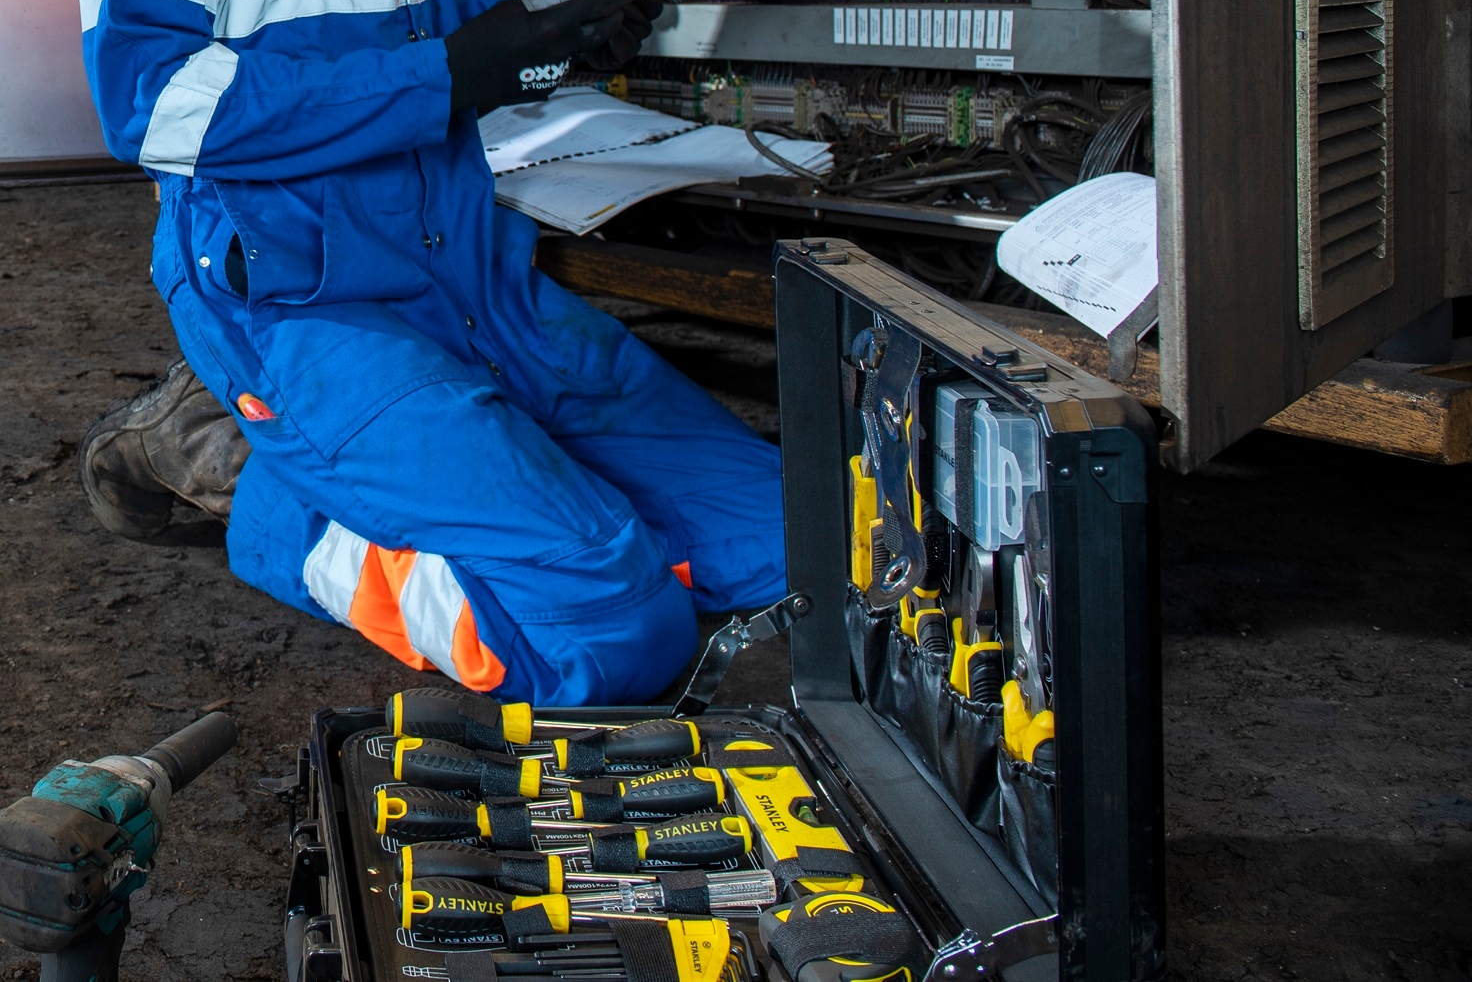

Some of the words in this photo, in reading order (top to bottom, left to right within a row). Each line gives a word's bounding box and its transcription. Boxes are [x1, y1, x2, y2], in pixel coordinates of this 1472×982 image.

[934, 443, 955, 468] STANLE
[630, 768, 690, 788] STANLEY
[411, 804, 470, 819] STANLEY
[755, 794, 790, 834] STANLEY
[654, 820, 718, 840] STANLEY
[437, 896, 504, 915] STANLEY
[690, 940, 702, 973] STANLEY
